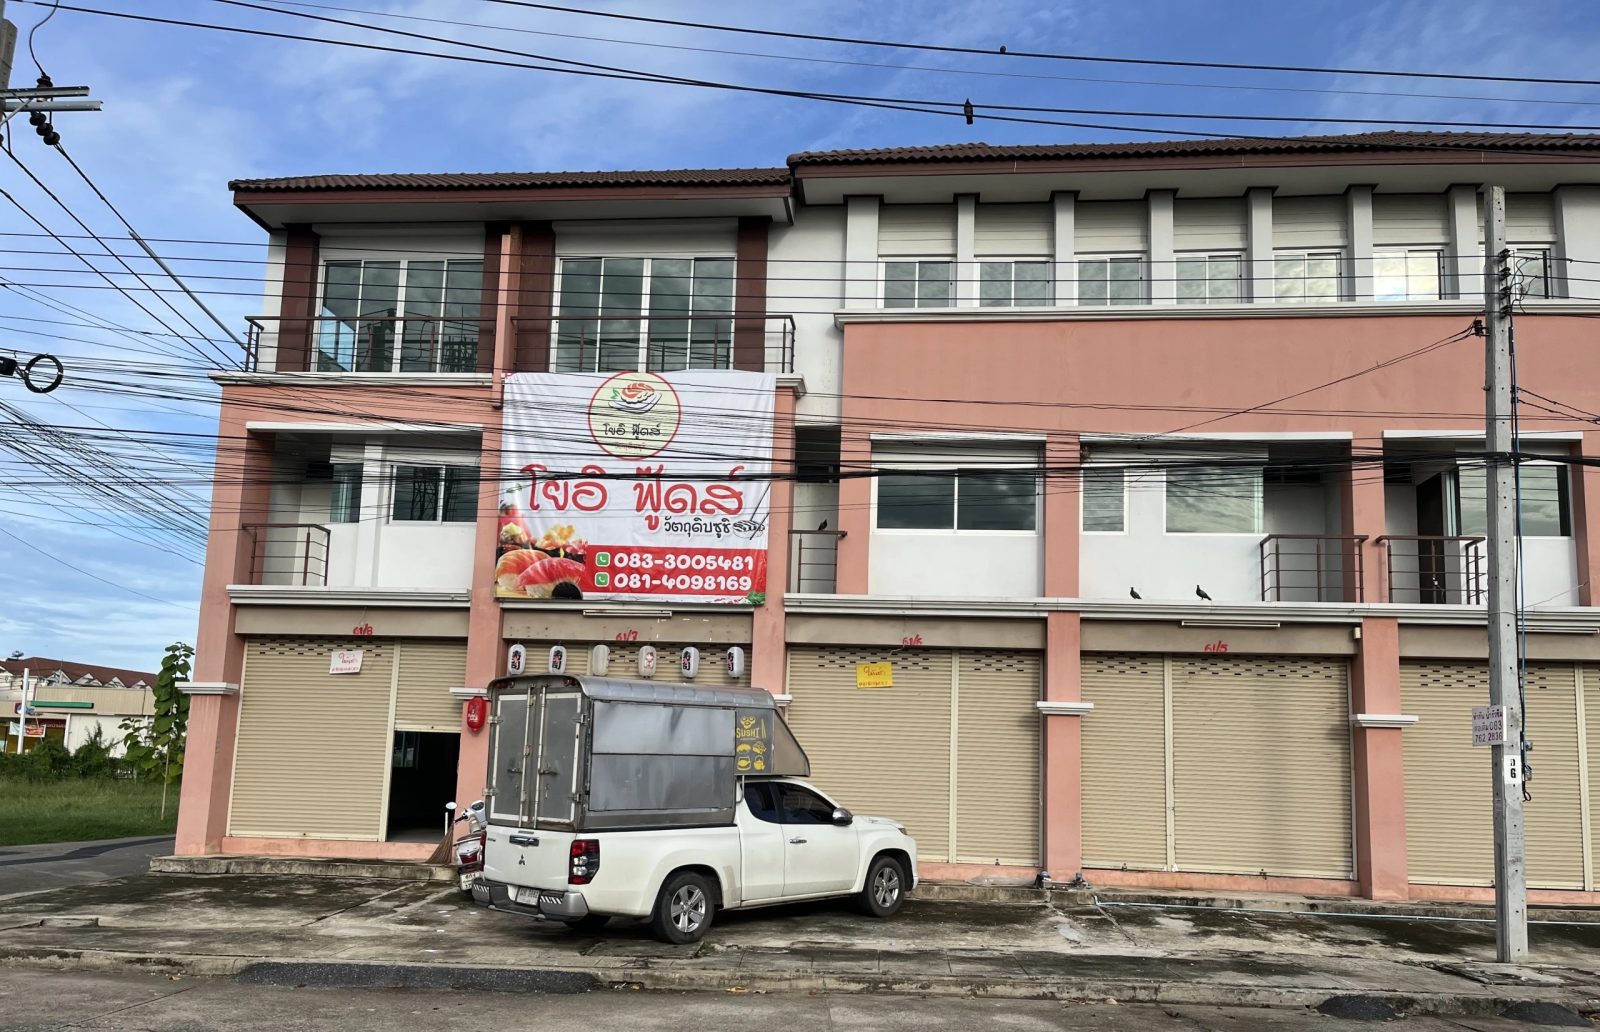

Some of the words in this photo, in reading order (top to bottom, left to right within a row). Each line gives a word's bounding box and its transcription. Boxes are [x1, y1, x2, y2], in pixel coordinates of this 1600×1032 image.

[664, 516, 731, 538] วัตถุดิบซูชิ
[614, 552, 754, 572] 083-3005481
[613, 573, 753, 591] 081-4098169
[353, 623, 373, 635] 61/8
[616, 629, 638, 641] 61/7
[1204, 640, 1228, 653] 61/5
[1489, 720, 1502, 731] 083
[736, 727, 760, 739] SUSHI
[1475, 733, 1486, 743] 762
